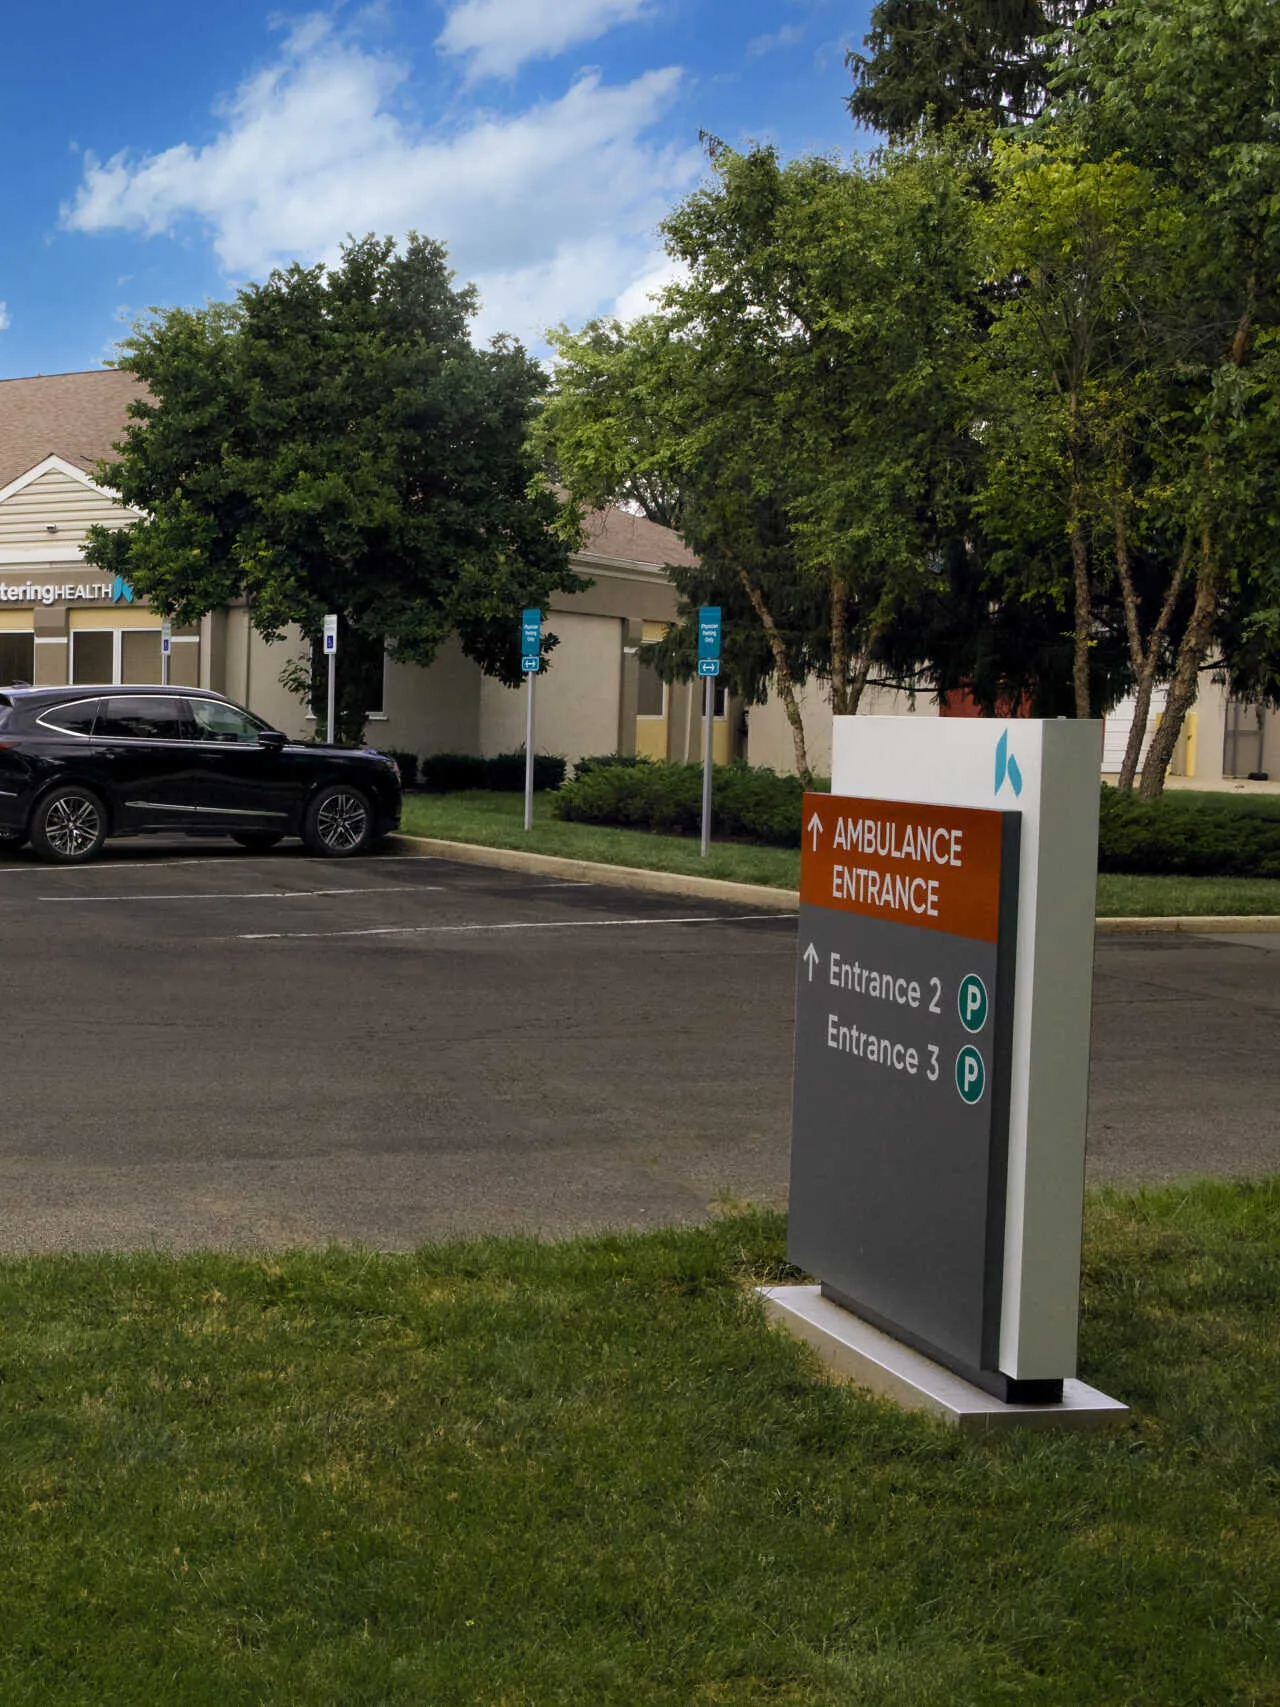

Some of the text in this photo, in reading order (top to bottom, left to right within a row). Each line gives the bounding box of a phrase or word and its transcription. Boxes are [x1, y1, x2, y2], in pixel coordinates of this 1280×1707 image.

[832, 816, 963, 867] AMBULANCE
[832, 864, 940, 917] ENTRANCE
[829, 951, 982, 1021] Entrance 2 P
[827, 1013, 979, 1092] Entrance 3 P
